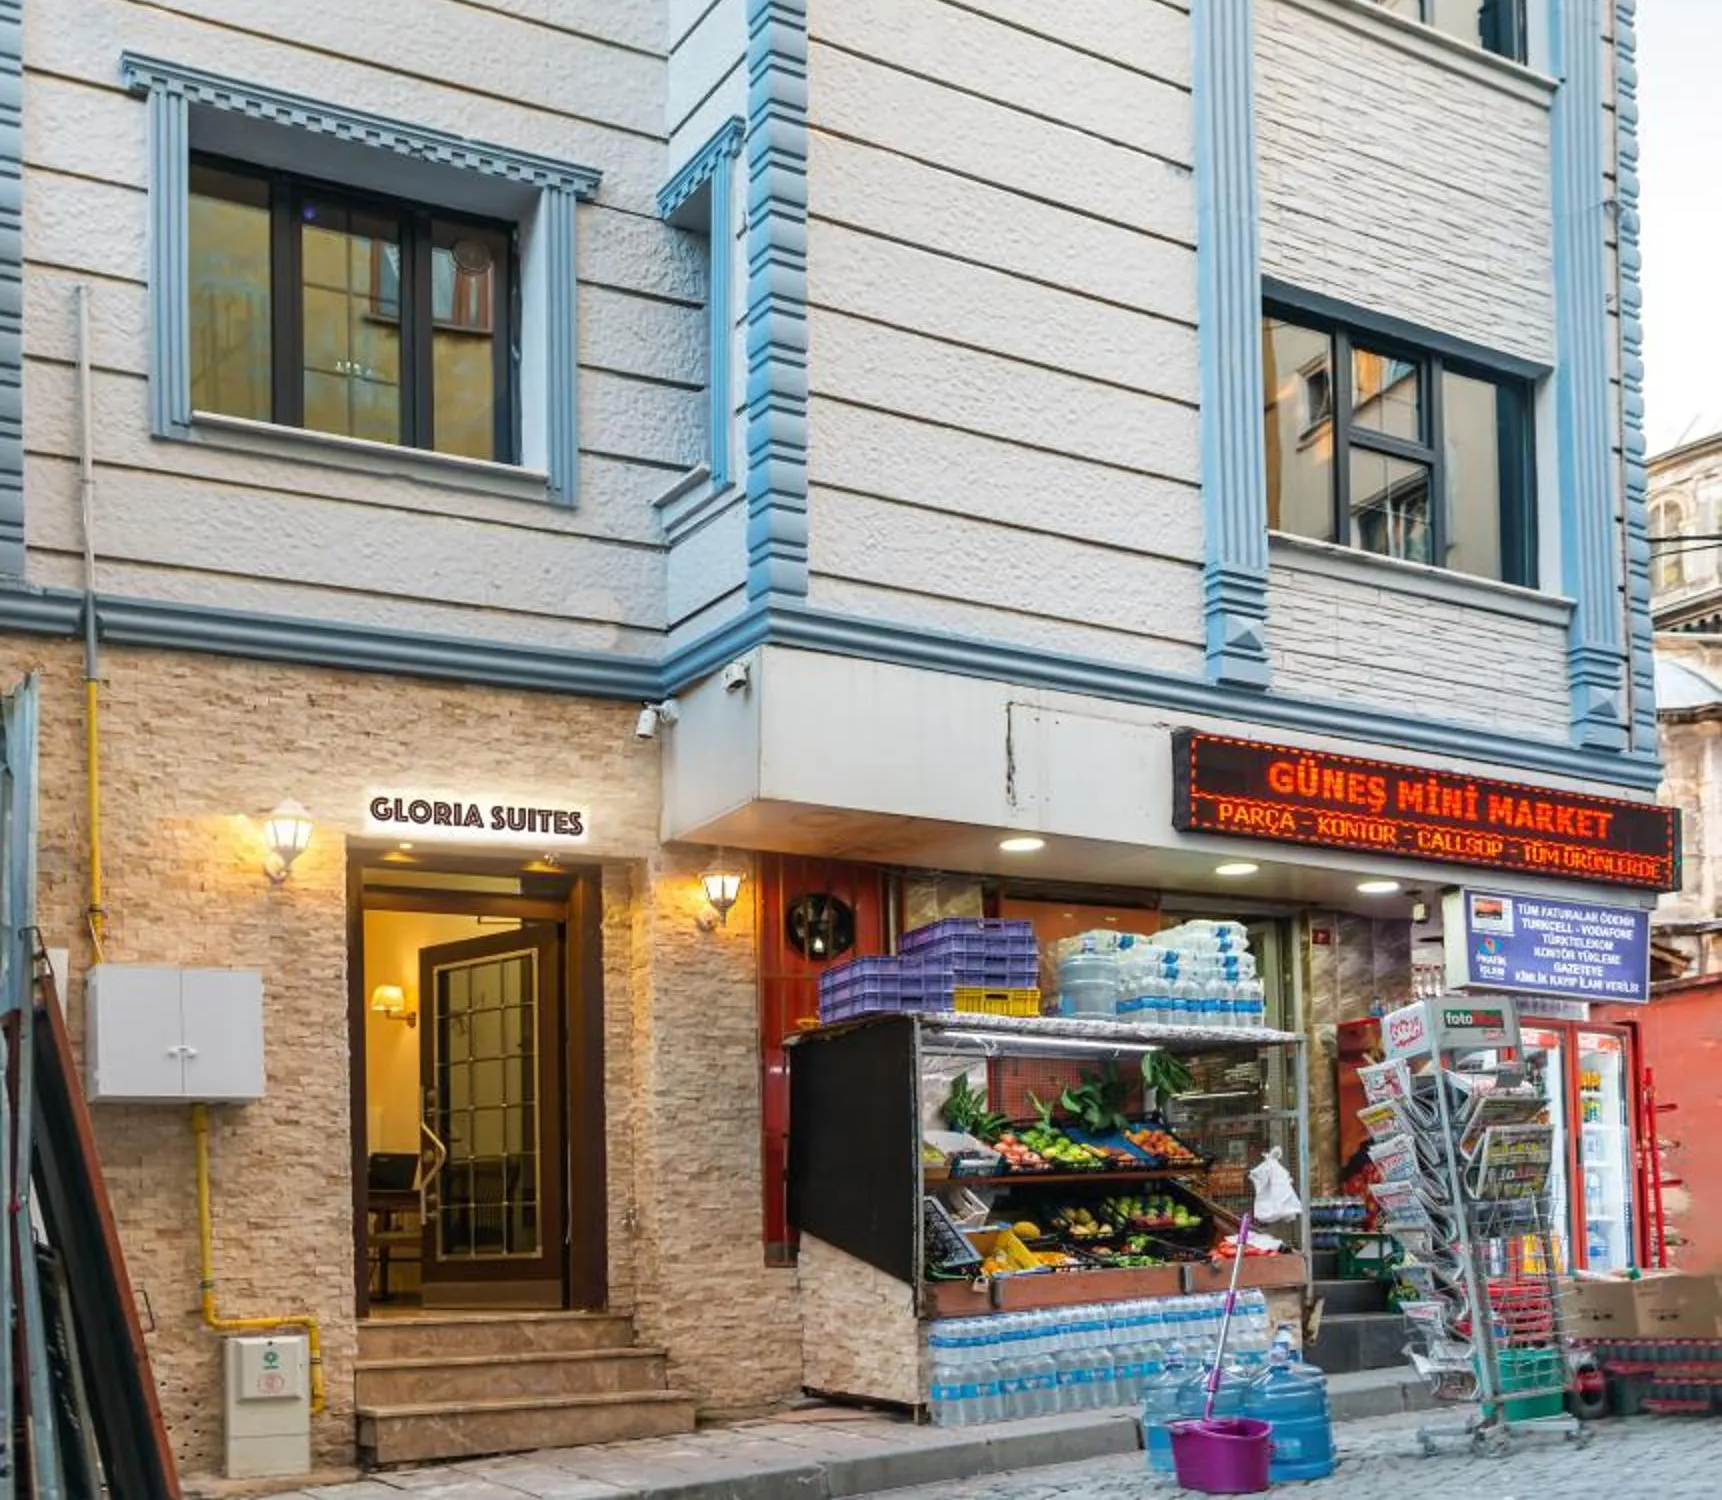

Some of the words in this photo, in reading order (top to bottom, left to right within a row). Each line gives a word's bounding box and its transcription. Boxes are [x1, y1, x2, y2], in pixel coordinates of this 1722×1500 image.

[1268, 757, 1387, 813] GÜNEŞ
[1398, 772, 1479, 821] MİNİ
[1488, 794, 1614, 840] MARKET
[369, 796, 485, 829] GLORIA
[490, 805, 584, 836] SUITES
[1218, 803, 1297, 835] PARÇA
[1517, 903, 1539, 916] TÜM
[1581, 924, 1635, 940] VODAFONE
